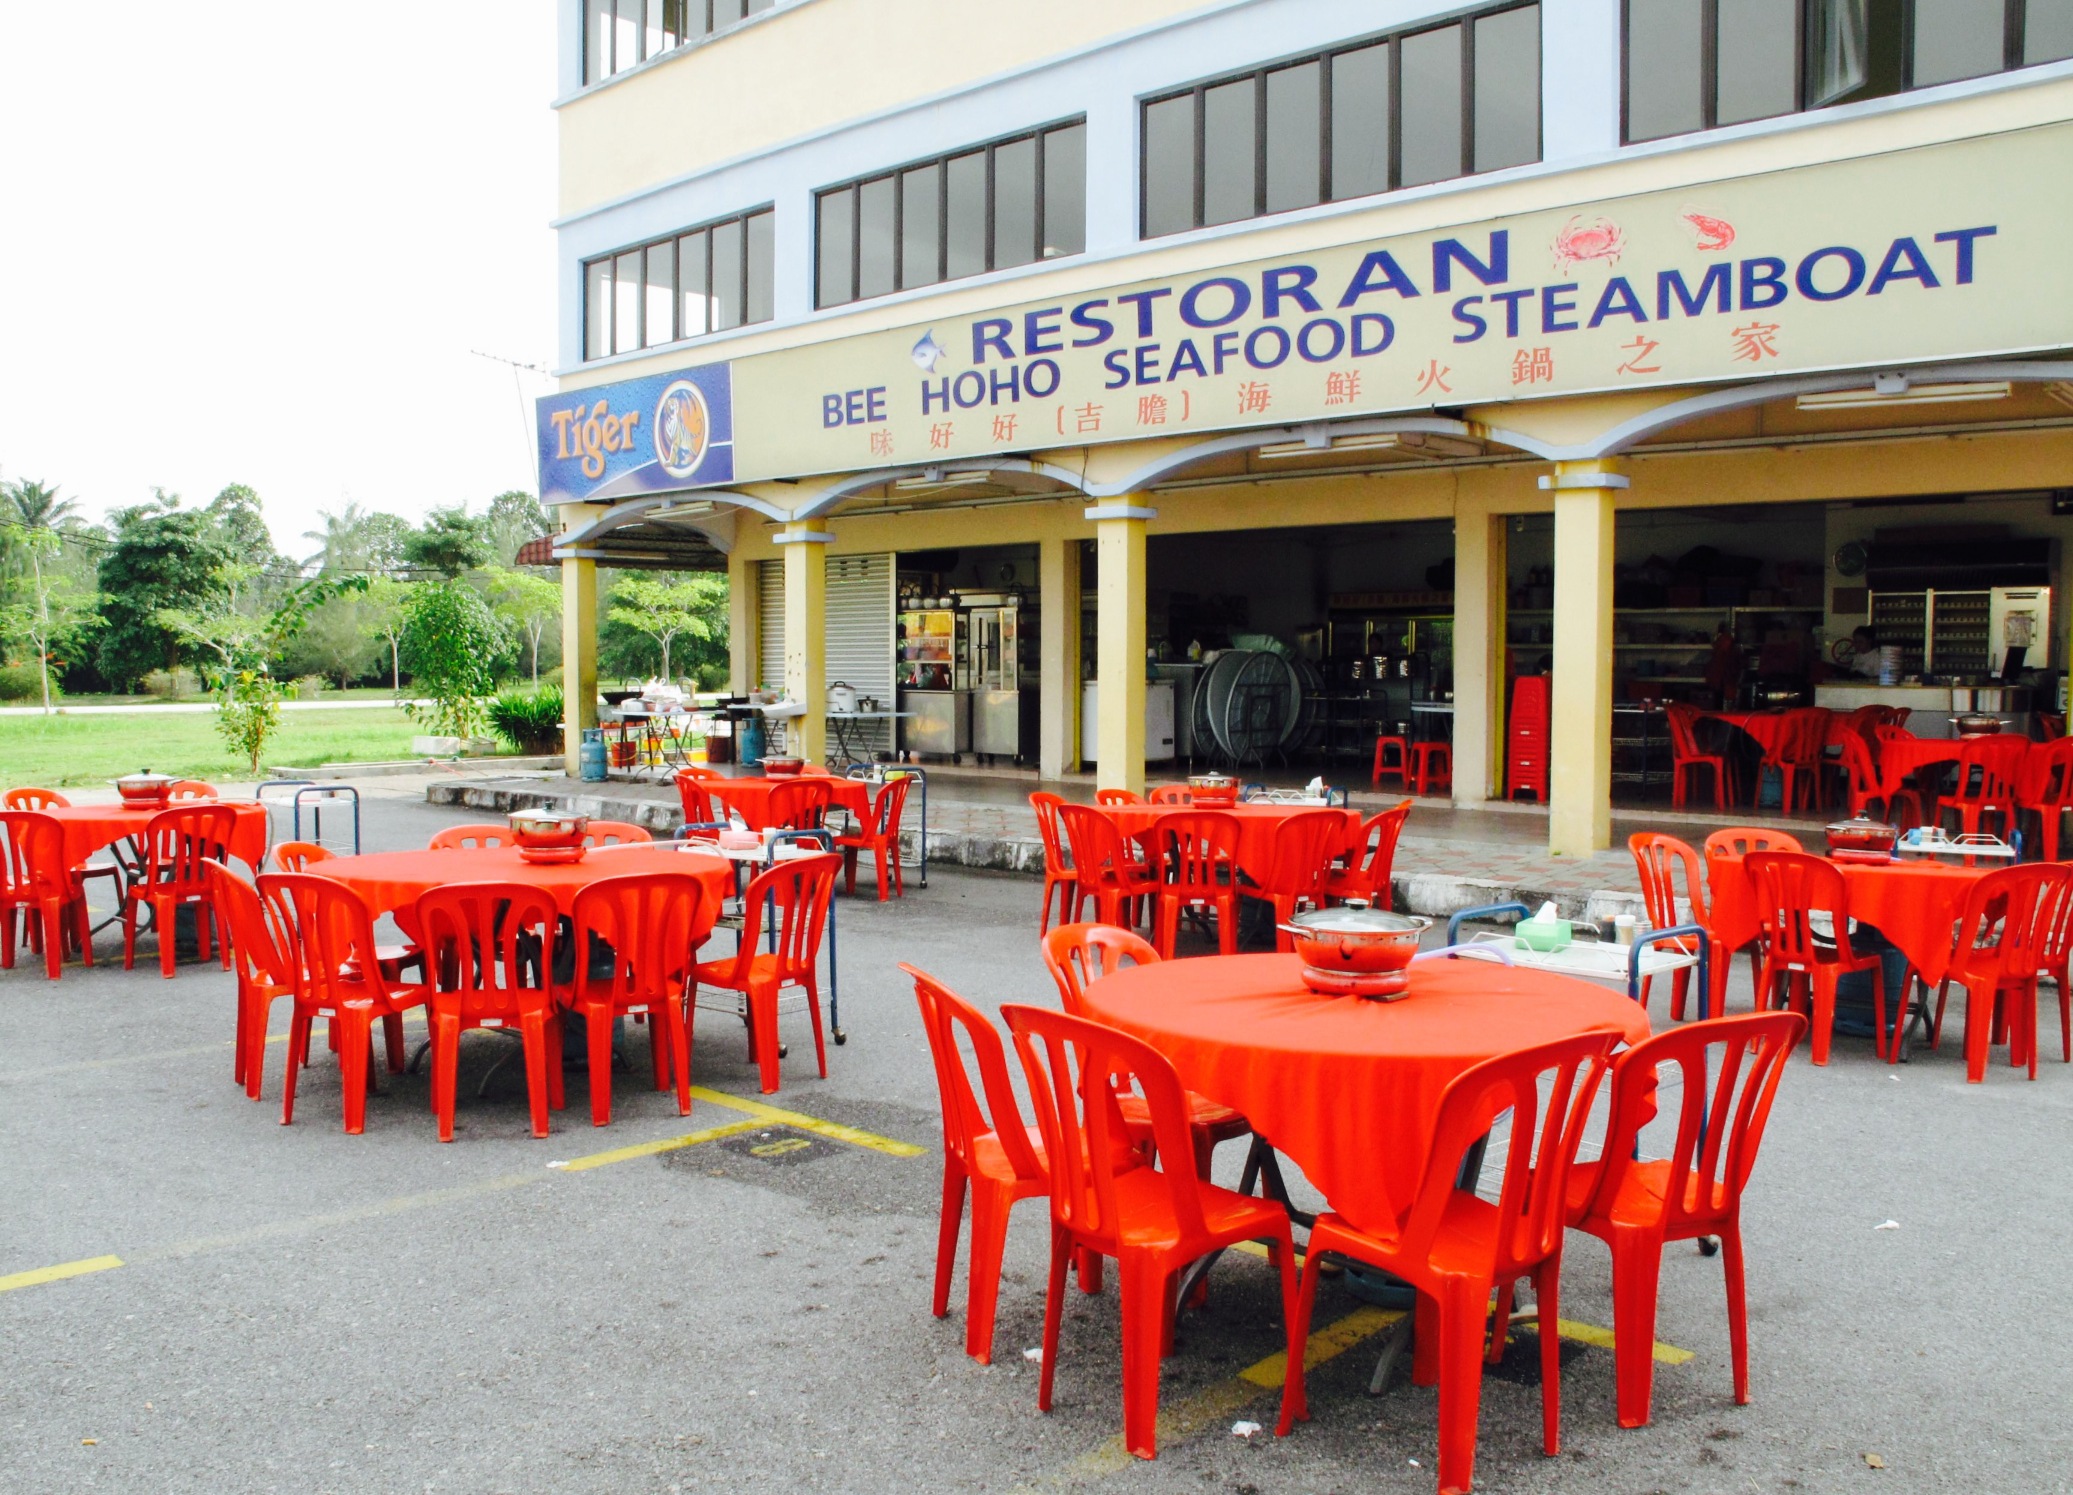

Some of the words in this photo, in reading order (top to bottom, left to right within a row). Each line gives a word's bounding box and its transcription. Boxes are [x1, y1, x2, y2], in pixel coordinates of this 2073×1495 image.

[822, 386, 887, 429] BEE
[922, 357, 1061, 416] HOHO
[1104, 312, 1396, 390] SEAFOOD
[1452, 225, 1999, 345] STEAMBOAT
[972, 230, 1510, 364] RESTORAN
[550, 399, 640, 479] Tiger
